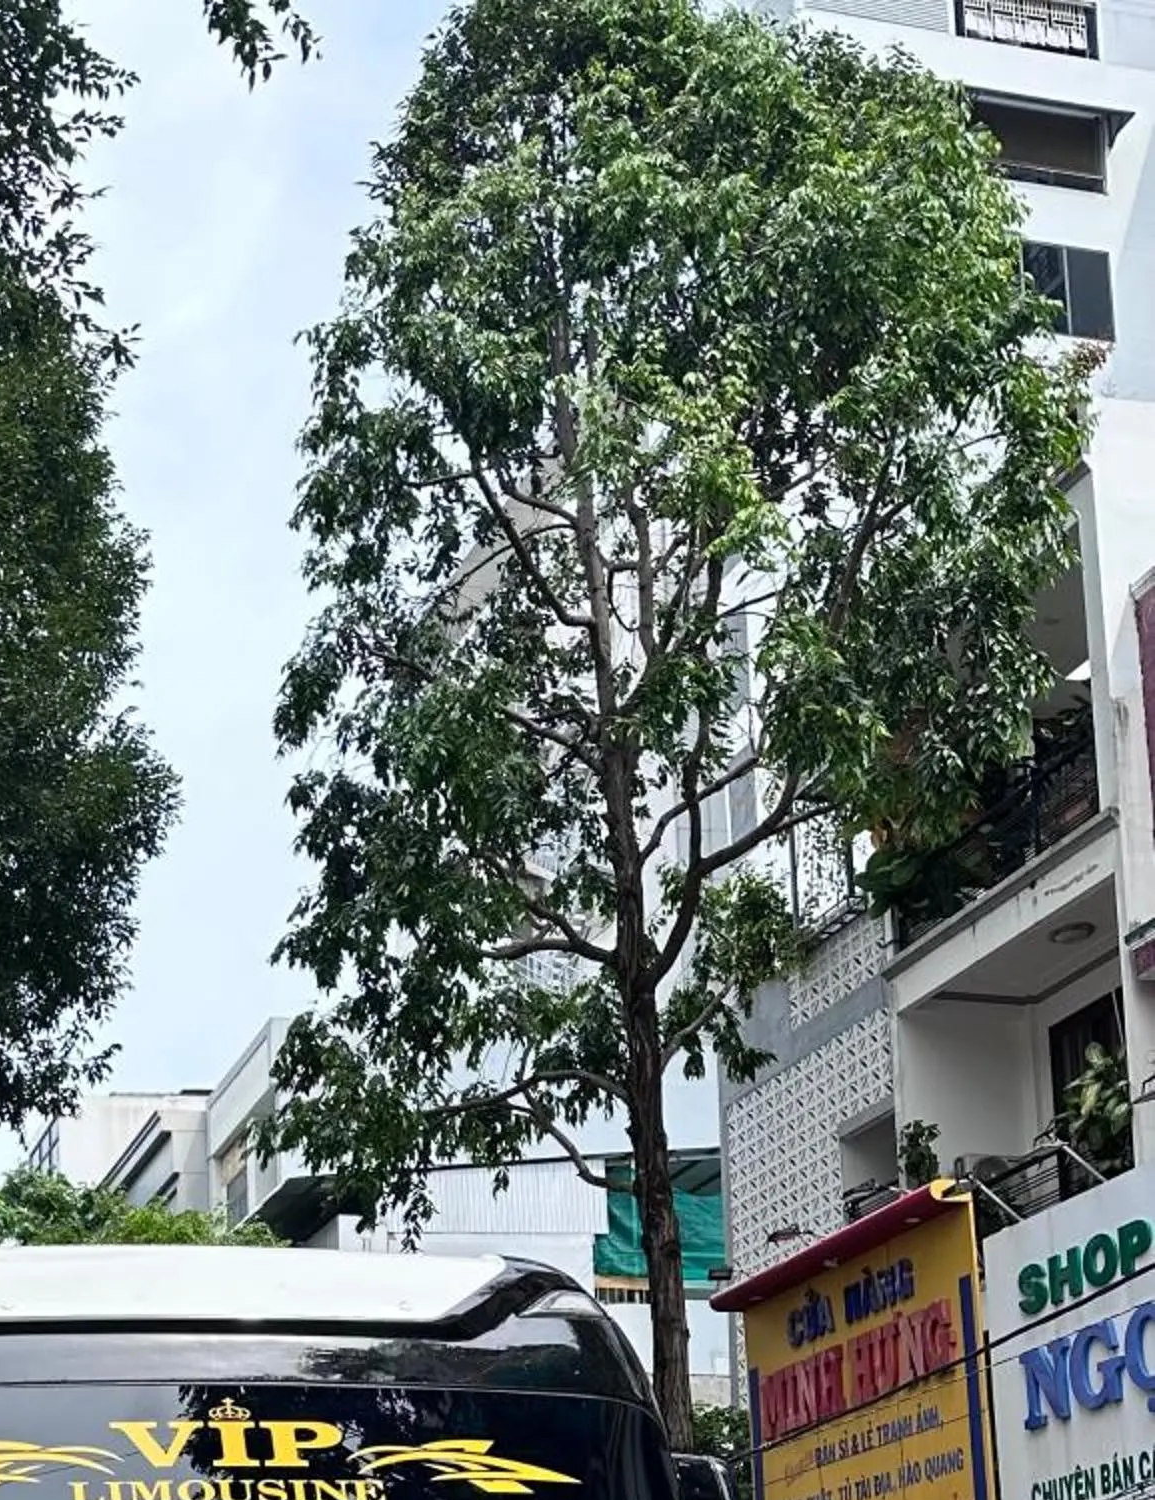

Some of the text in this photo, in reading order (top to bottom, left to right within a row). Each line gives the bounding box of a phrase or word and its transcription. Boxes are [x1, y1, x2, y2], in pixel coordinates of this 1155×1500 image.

[843, 1258, 915, 1325] HÀNG
[1018, 1219, 1153, 1315] SHOP
[109, 1420, 347, 1468] VIP
[1100, 1451, 1135, 1494] BÁN
